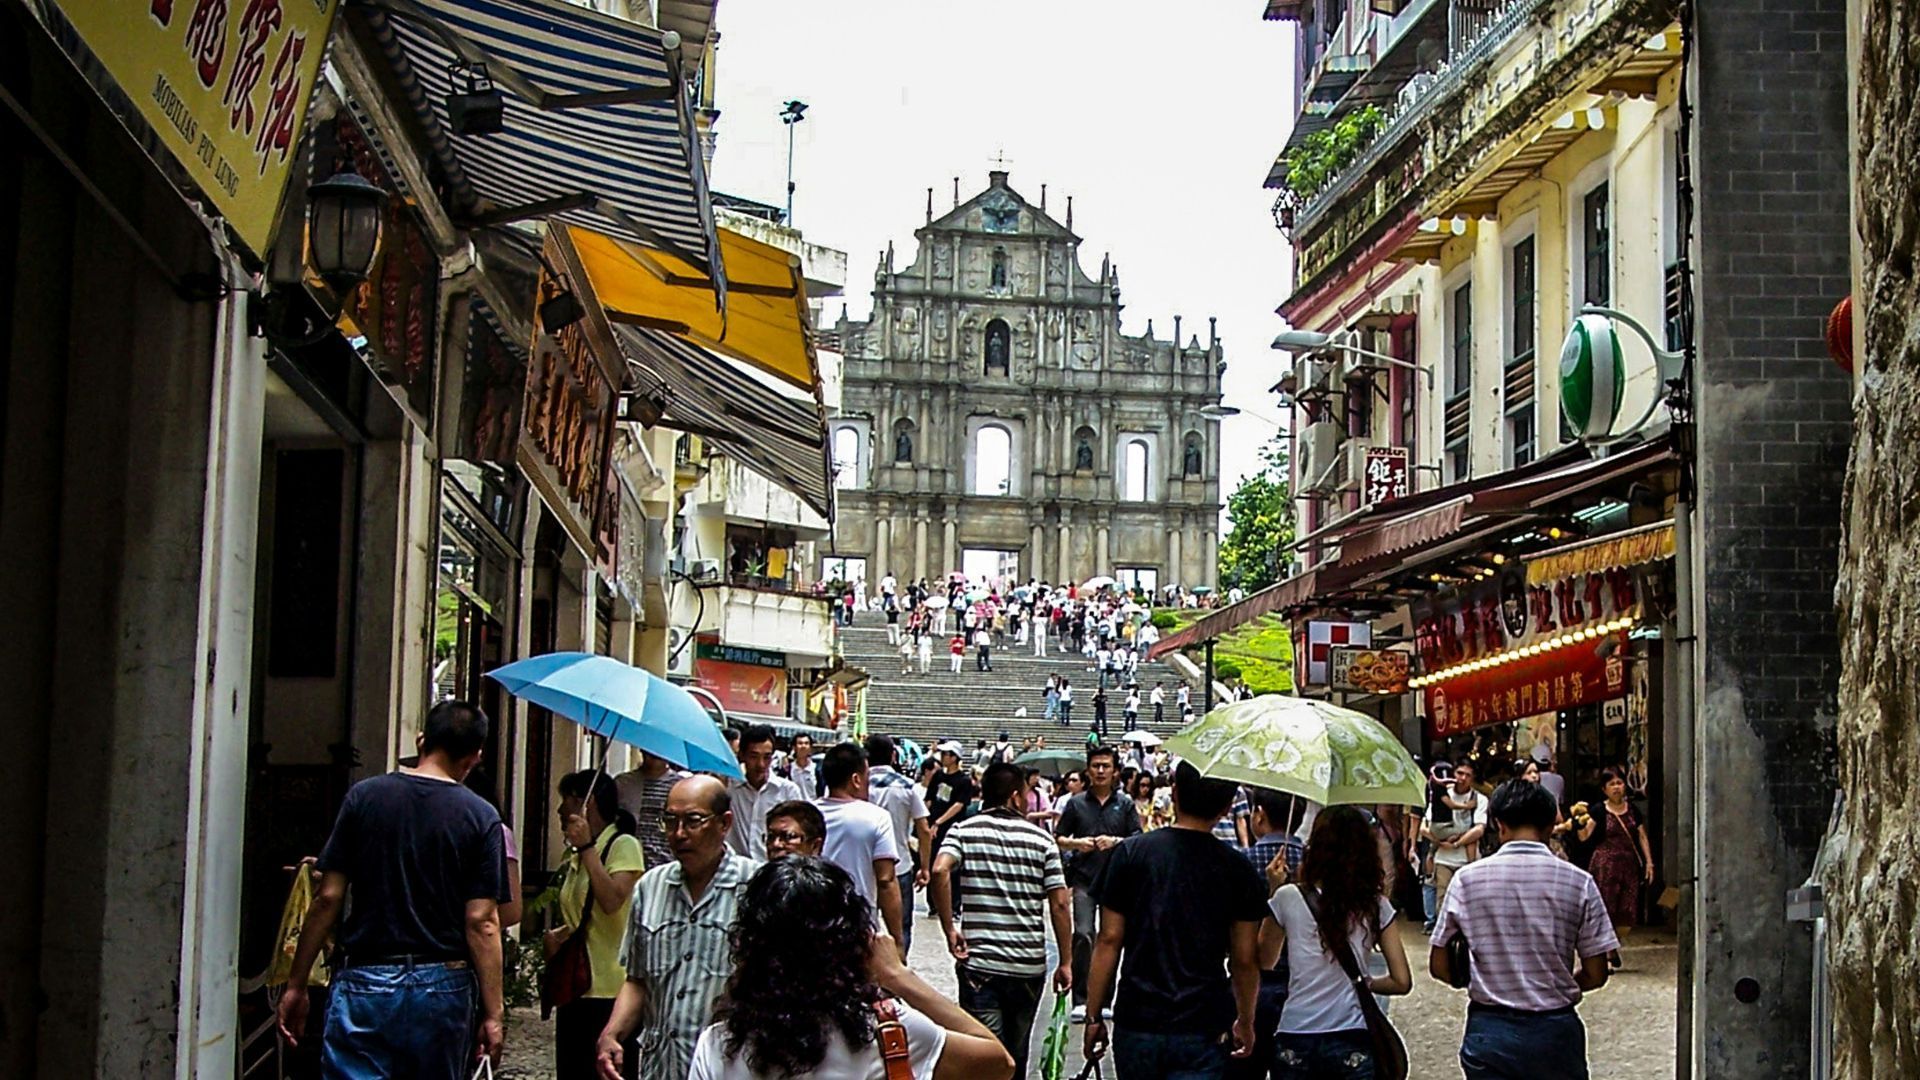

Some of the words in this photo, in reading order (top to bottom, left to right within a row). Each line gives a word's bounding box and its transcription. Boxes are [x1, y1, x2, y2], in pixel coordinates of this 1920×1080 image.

[152, 74, 198, 145] MOBILIAS
[197, 133, 217, 168] PUI
[214, 156, 240, 197] LUNG
